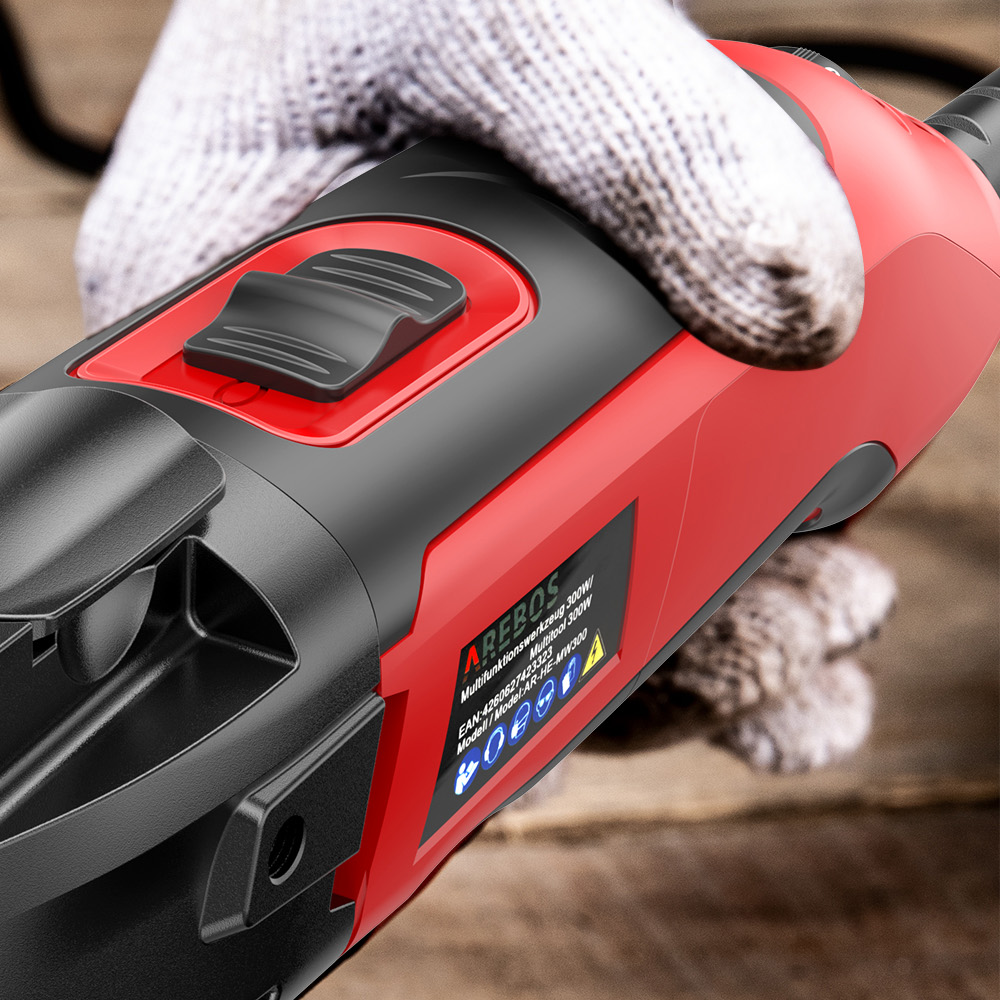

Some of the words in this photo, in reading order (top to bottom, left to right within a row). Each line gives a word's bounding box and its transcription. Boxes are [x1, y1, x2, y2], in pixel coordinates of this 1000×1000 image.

[460, 603, 565, 704] Multifunktionswerkzeug
[566, 574, 594, 609] 300W/
[462, 571, 559, 684] AREBOS
[530, 617, 567, 661] Multitool
[567, 593, 593, 626] 300W
[457, 717, 489, 755] Modell
